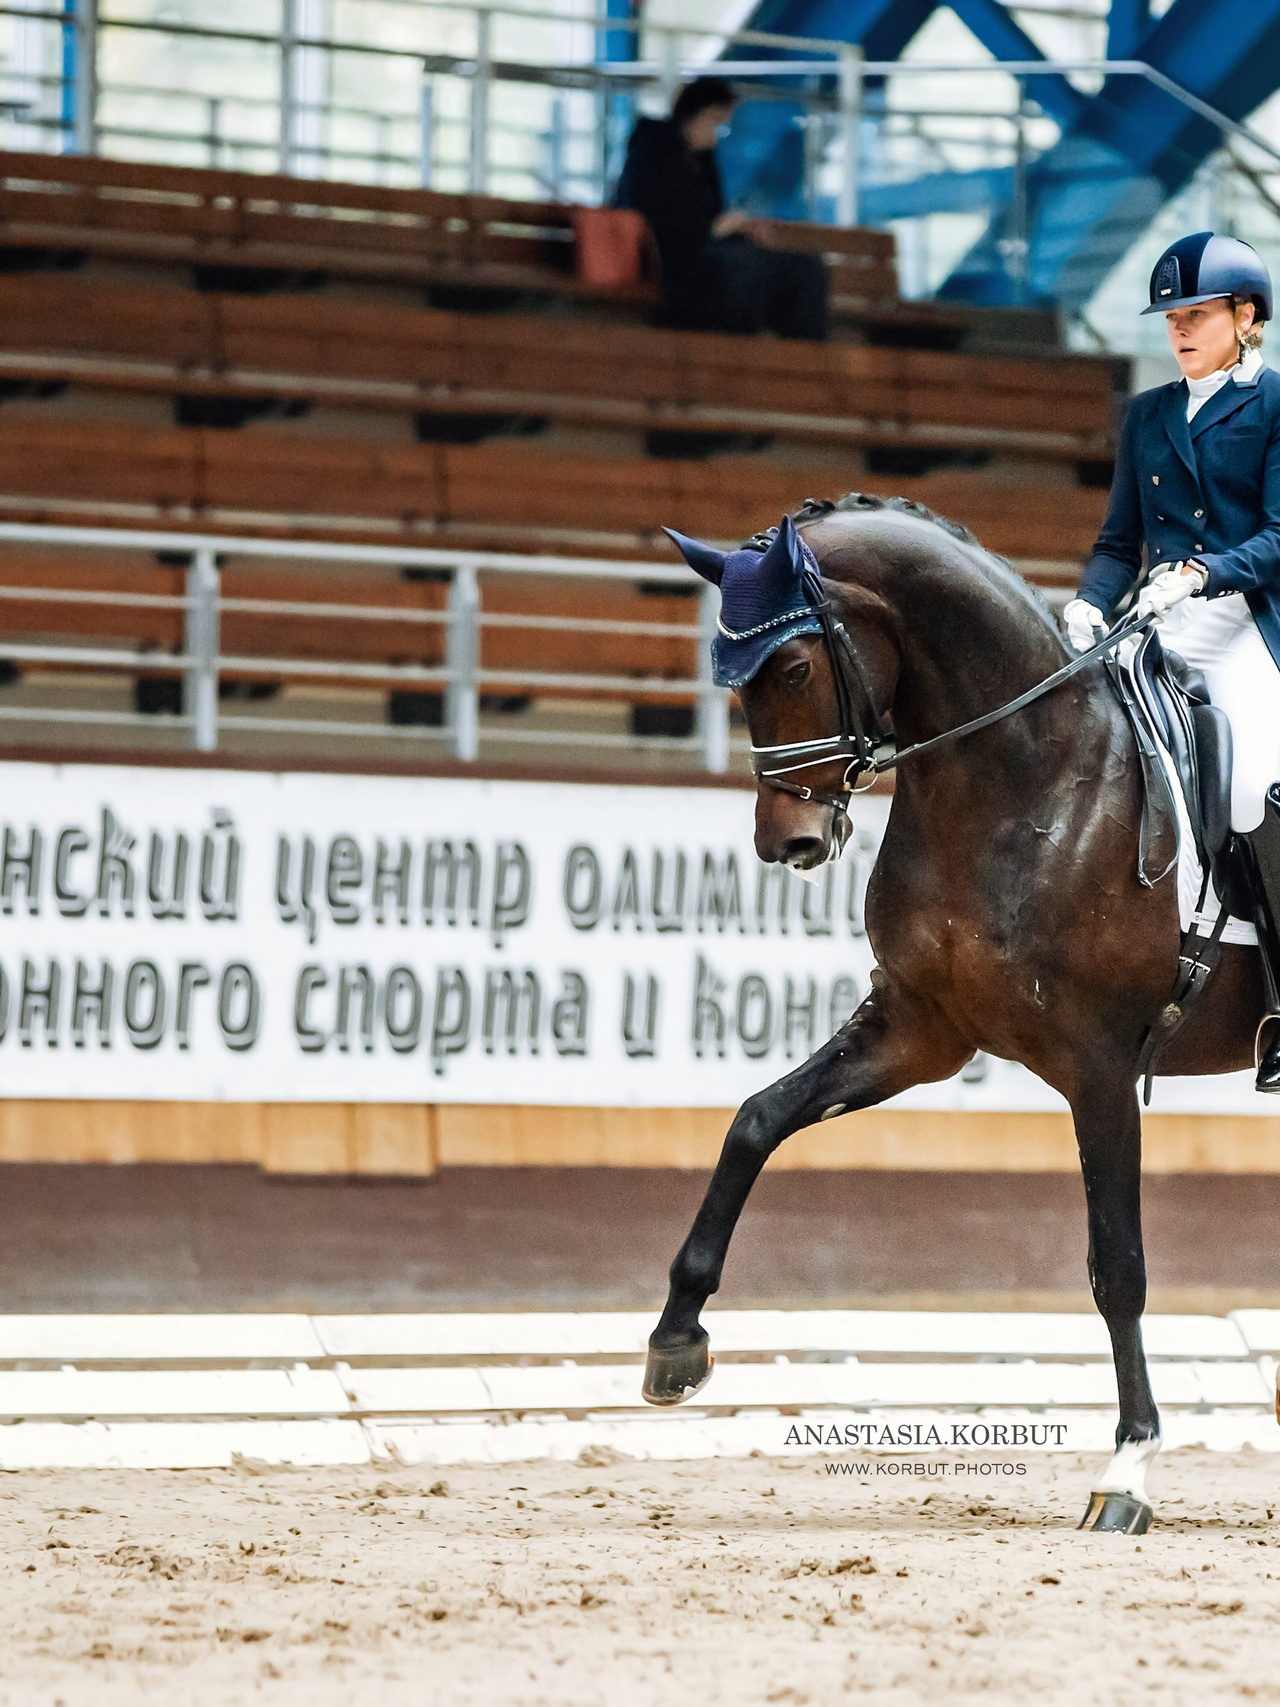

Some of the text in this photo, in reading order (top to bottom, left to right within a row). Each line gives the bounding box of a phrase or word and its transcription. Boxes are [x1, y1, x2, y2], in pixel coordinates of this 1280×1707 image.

[274, 833, 531, 950] центр
[0, 957, 261, 1052] нного
[295, 965, 588, 1076] спорта
[621, 970, 662, 1059] и
